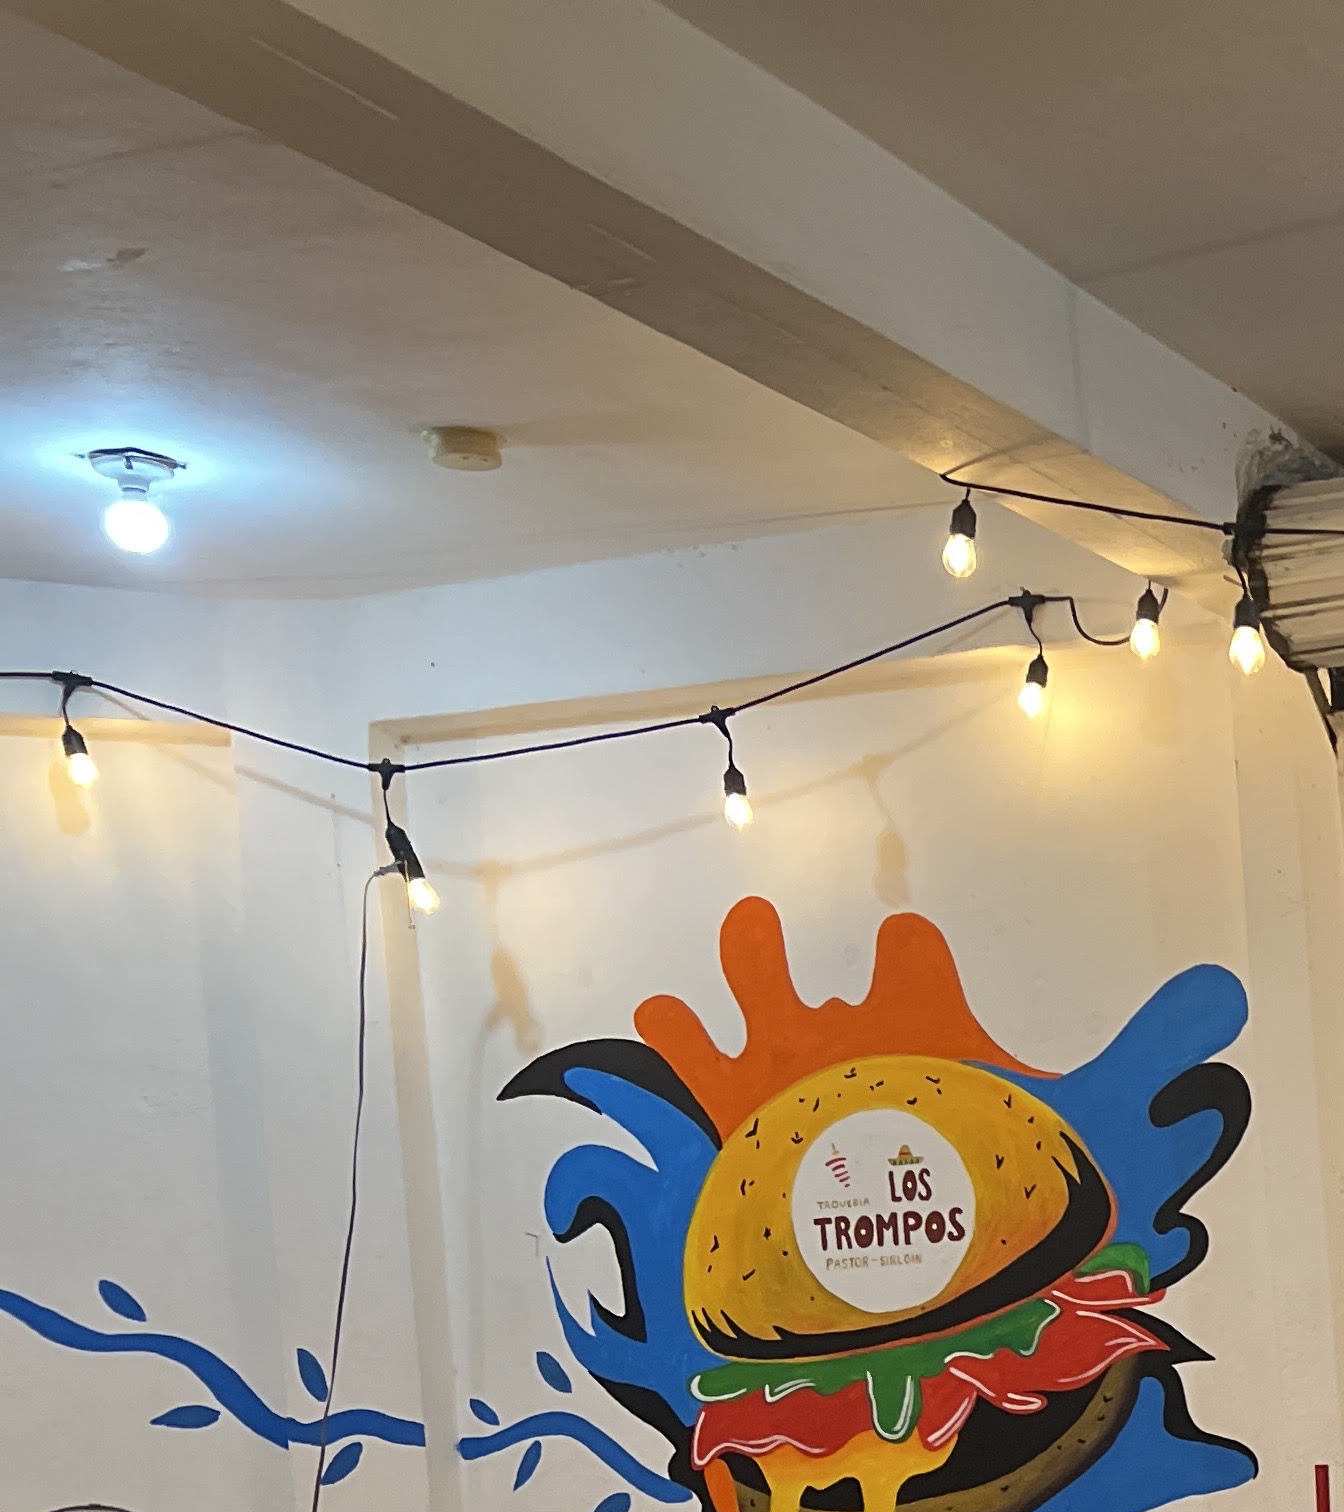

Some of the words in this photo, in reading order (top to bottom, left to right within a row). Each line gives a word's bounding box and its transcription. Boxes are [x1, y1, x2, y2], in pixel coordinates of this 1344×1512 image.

[888, 1167, 932, 1203] LOS
[813, 1206, 966, 1252] TROMPOS
[826, 1255, 869, 1271] PASTOR
[879, 1253, 923, 1267] SIRLOIN
